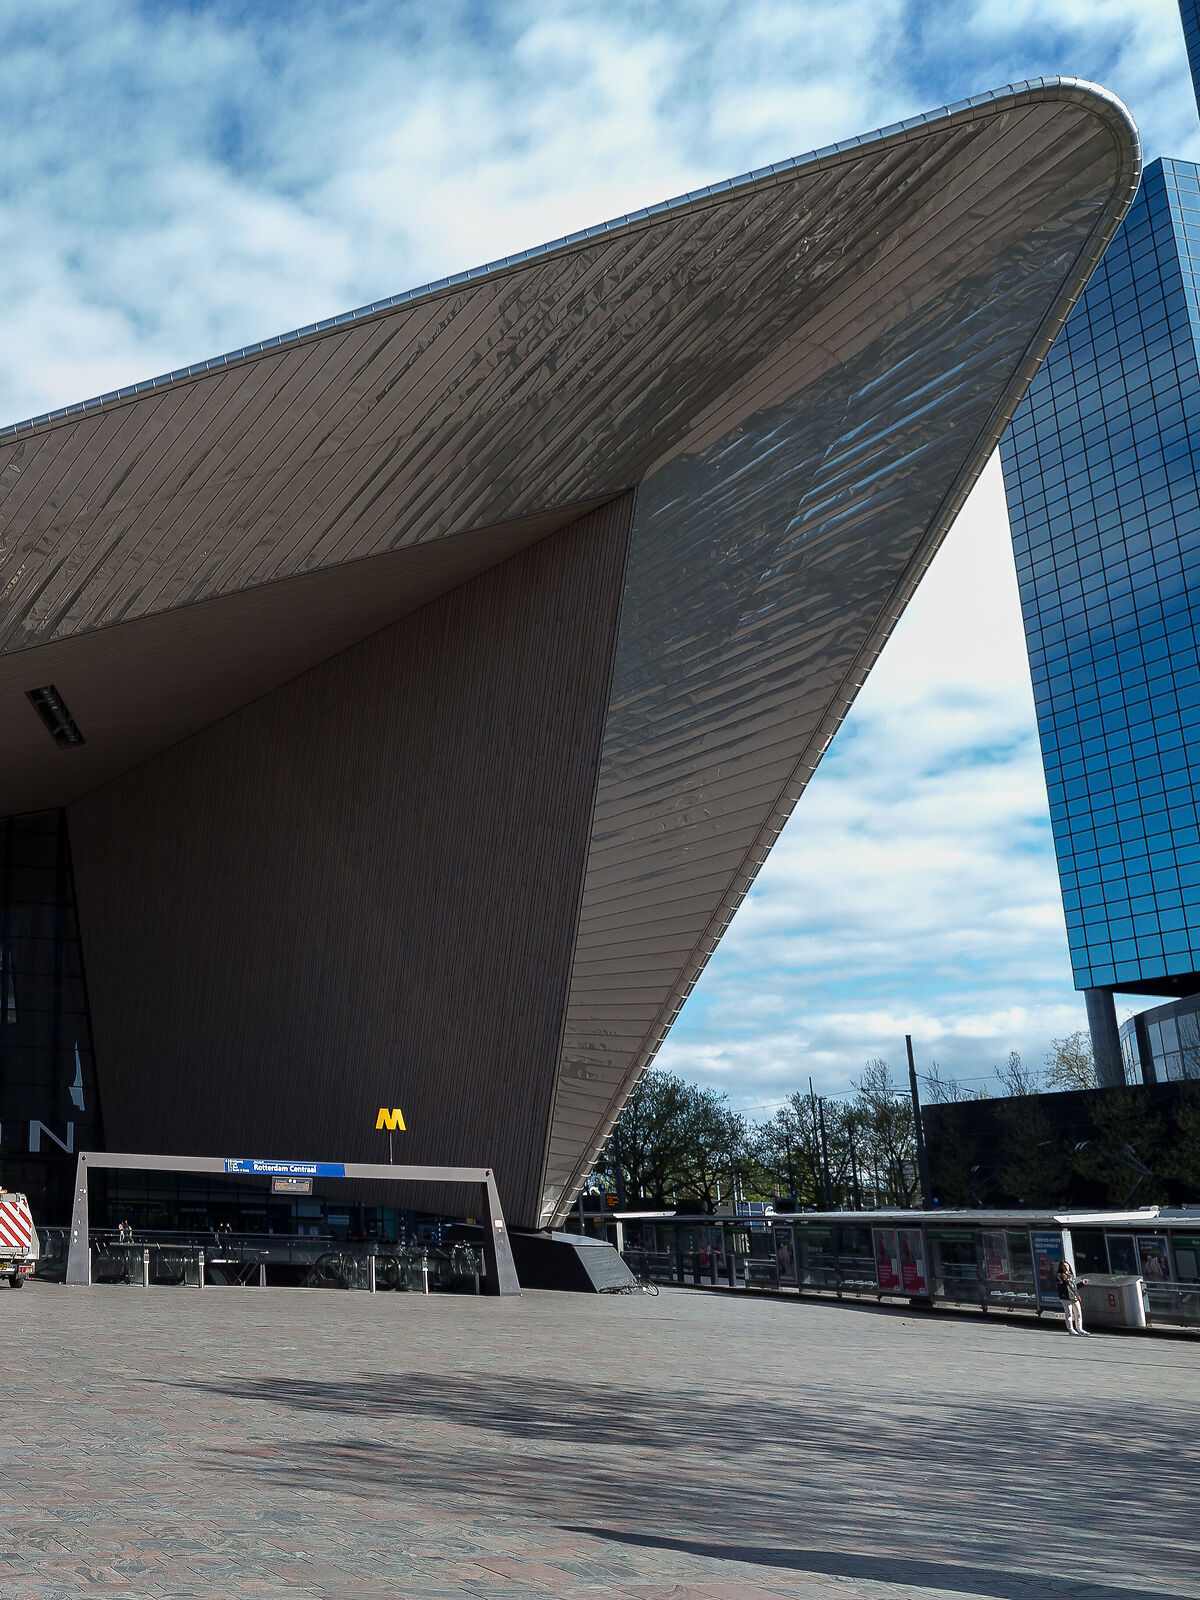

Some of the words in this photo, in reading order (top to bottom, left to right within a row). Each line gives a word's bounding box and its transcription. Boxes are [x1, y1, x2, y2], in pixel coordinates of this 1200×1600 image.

[375, 1107, 407, 1131] M
[254, 1164, 289, 1172] Rotterdam
[289, 1165, 317, 1173] Centraal
